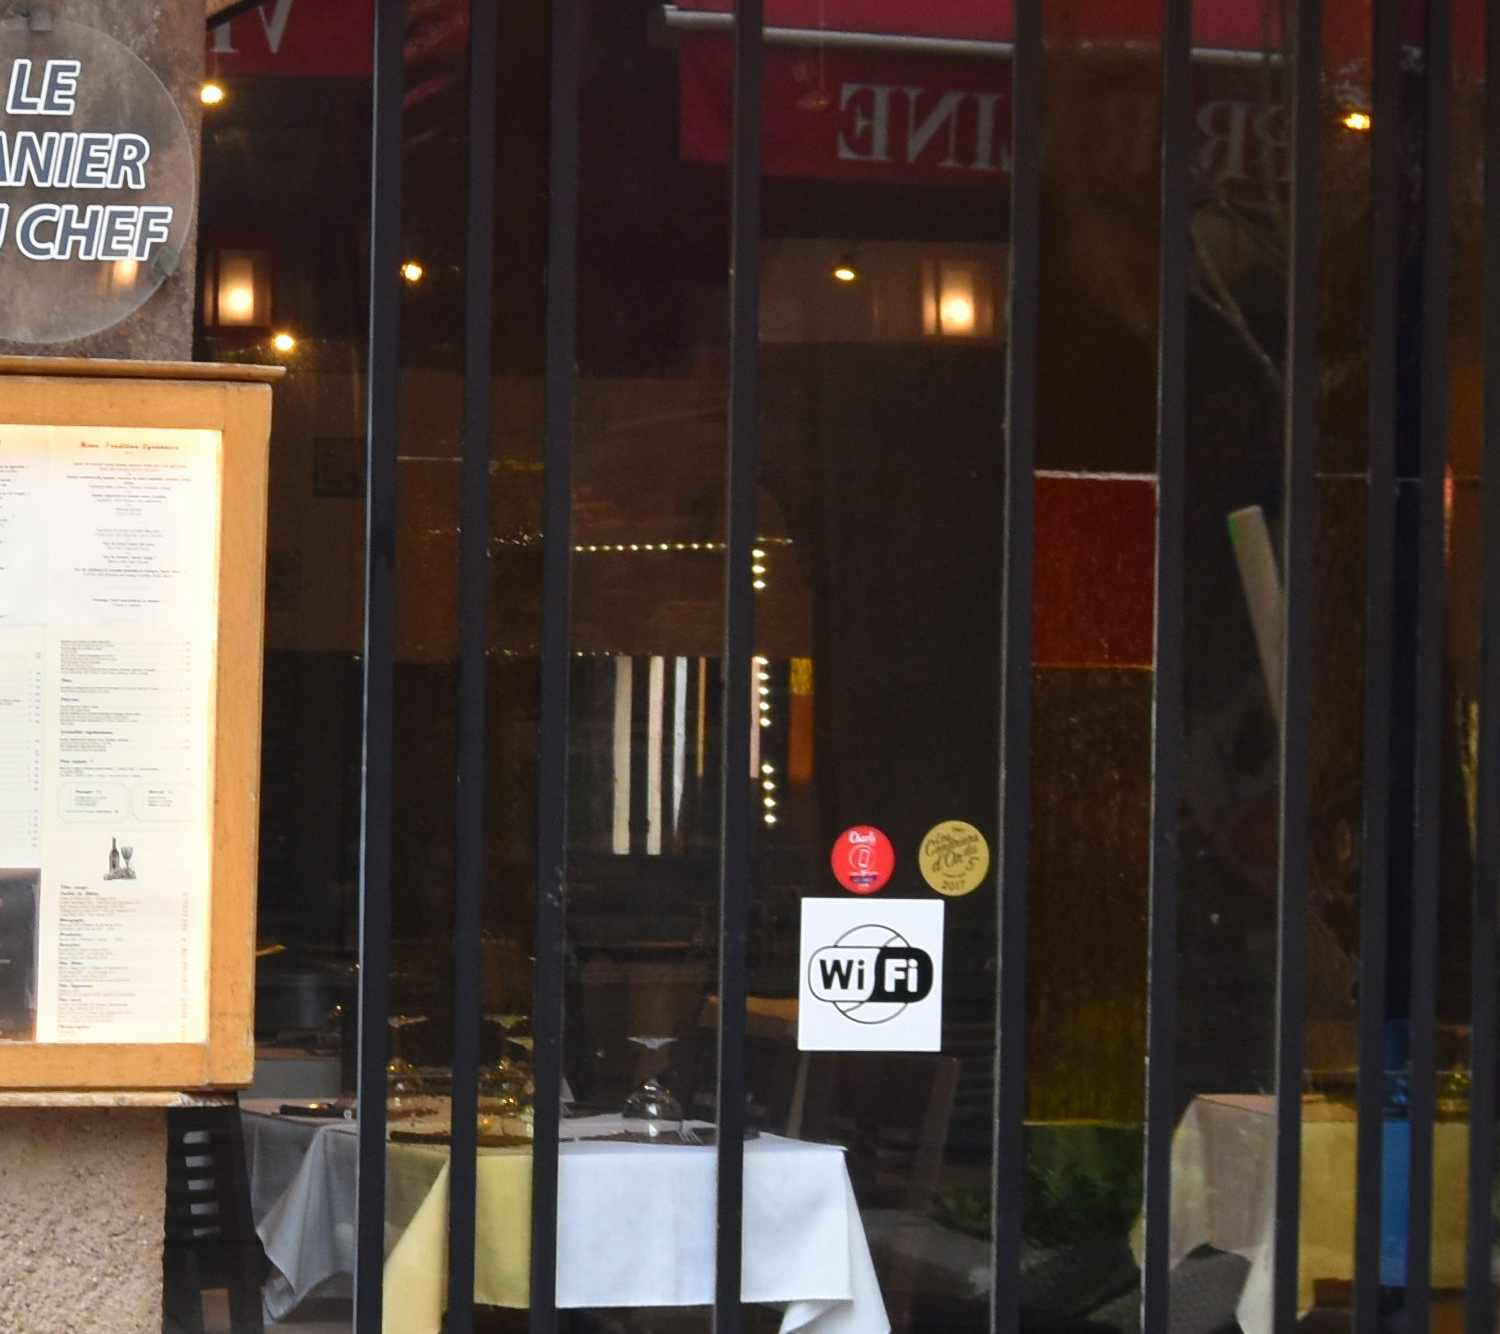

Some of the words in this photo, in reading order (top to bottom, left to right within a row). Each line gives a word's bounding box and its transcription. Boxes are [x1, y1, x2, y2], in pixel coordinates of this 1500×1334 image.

[5, 58, 82, 116] LE
[14, 203, 174, 261] CHEF
[942, 879, 967, 891] 2017
